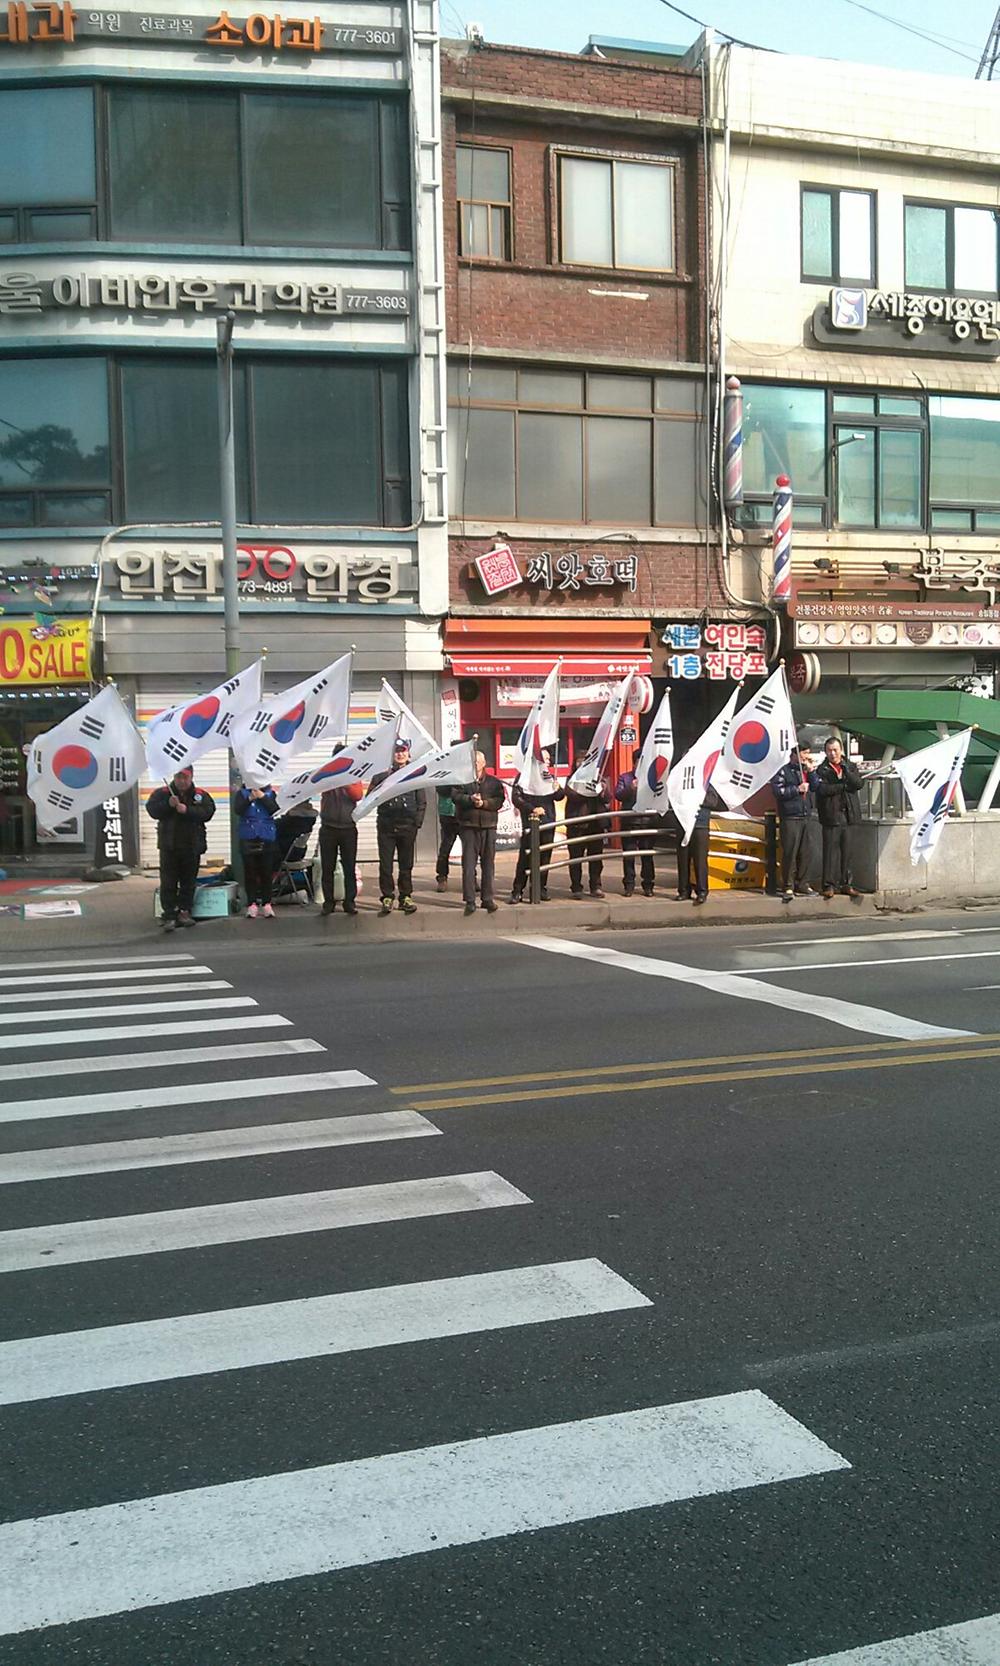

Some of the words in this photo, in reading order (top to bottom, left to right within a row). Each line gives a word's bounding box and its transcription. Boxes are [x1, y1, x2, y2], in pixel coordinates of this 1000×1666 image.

[87, 12, 121, 32] 의원
[139, 16, 194, 35] 진료과목
[205, 11, 325, 51] 소아과
[333, 28, 397, 45] 777-3601
[346, 294, 407, 310] 777-3603
[868, 292, 1000, 340] 세종이용원
[116, 550, 216, 595] 인천
[304, 554, 400, 599] 안경
[527, 552, 638, 592] 씨앗호떡
[705, 624, 766, 649] 여인숙
[28, 641, 87, 679] SALE
[668, 654, 701, 678] 1층
[705, 653, 768, 679] 전당포
